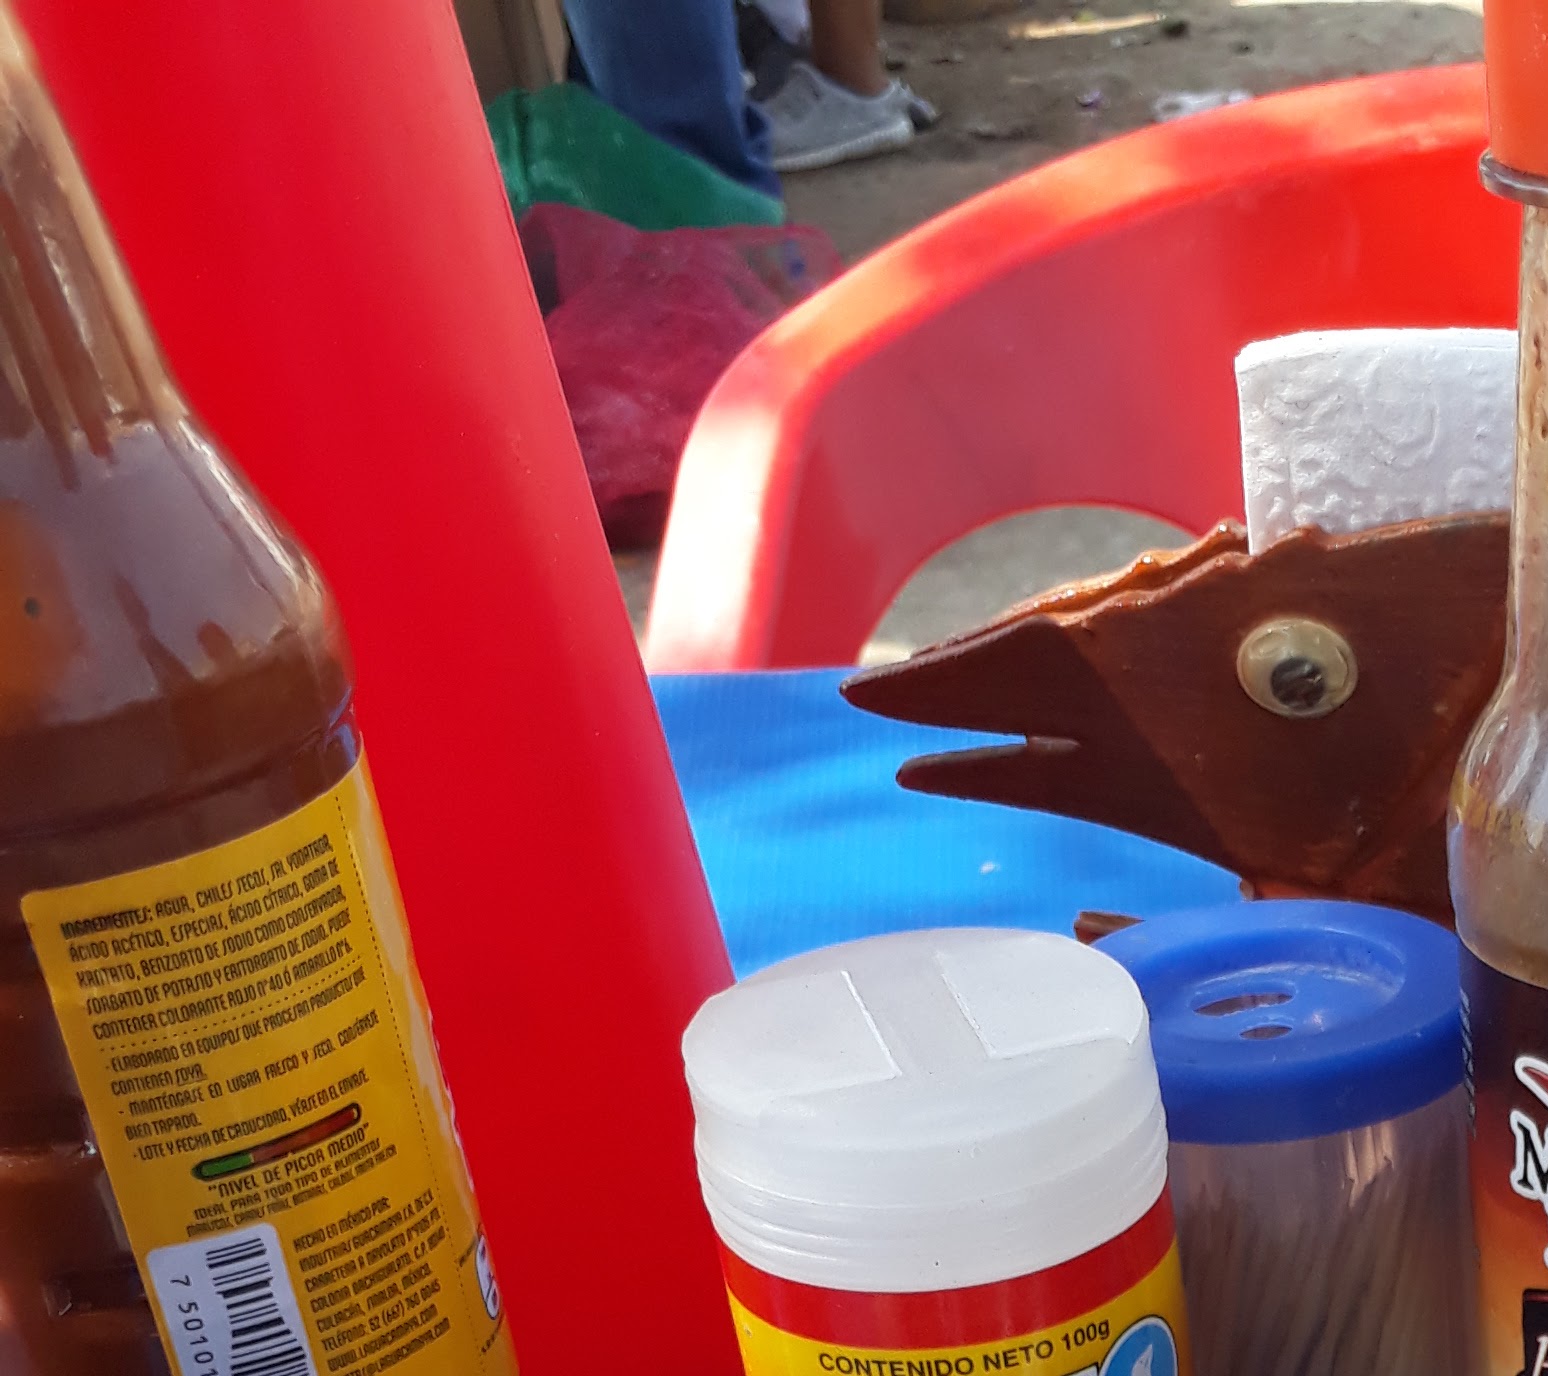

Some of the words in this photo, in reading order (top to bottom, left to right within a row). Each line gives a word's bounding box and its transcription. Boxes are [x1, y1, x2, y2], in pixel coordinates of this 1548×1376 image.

[155, 896, 195, 918] AGUA,
[196, 879, 233, 908] CHILES
[236, 868, 270, 895] SECOS,
[270, 860, 287, 881] SAL
[69, 940, 109, 963] ÁCIDO
[112, 929, 170, 957] ACÉTICO,
[170, 911, 228, 943] ESPECIAS,
[228, 899, 262, 925] ÁCIDO
[263, 881, 304, 912] CÍTRICO,
[140, 947, 204, 977] BENZOATO
[205, 941, 220, 960] DE
[222, 930, 254, 957] SODIO
[254, 917, 286, 943] COMO
[86, 989, 143, 1015] SORBATO
[144, 985, 161, 1003] DE
[162, 971, 213, 998] POTASIO
[213, 968, 223, 985] Y
[287, 938, 302, 957] DE
[92, 1013, 158, 1040] CONTENER
[158, 994, 229, 1028] COLORANTE
[228, 985, 257, 1008] ROJO
[180, 1041, 196, 1058] EN
[196, 1026, 241, 1055] EQUIPOS
[242, 1020, 263, 1041] QUE
[263, 1000, 310, 1032] PROCESAN
[110, 1070, 174, 1096] CONTIENEN
[128, 1087, 205, 1117] MANTÉNGASE
[208, 1082, 223, 1099] EN
[226, 1069, 262, 1093] LUGAR
[264, 1055, 299, 1081] FRESCO
[302, 1050, 310, 1064] Y
[166, 1141, 174, 1155] Y
[175, 1133, 212, 1153] FECHA
[211, 1127, 229, 1146] DE
[263, 1167, 281, 1185] DE
[284, 1150, 326, 1178] PICOR
[170, 1274, 192, 1288] 7
[983, 1340, 1053, 1372] NETO
[1062, 1319, 1110, 1350] 100g
